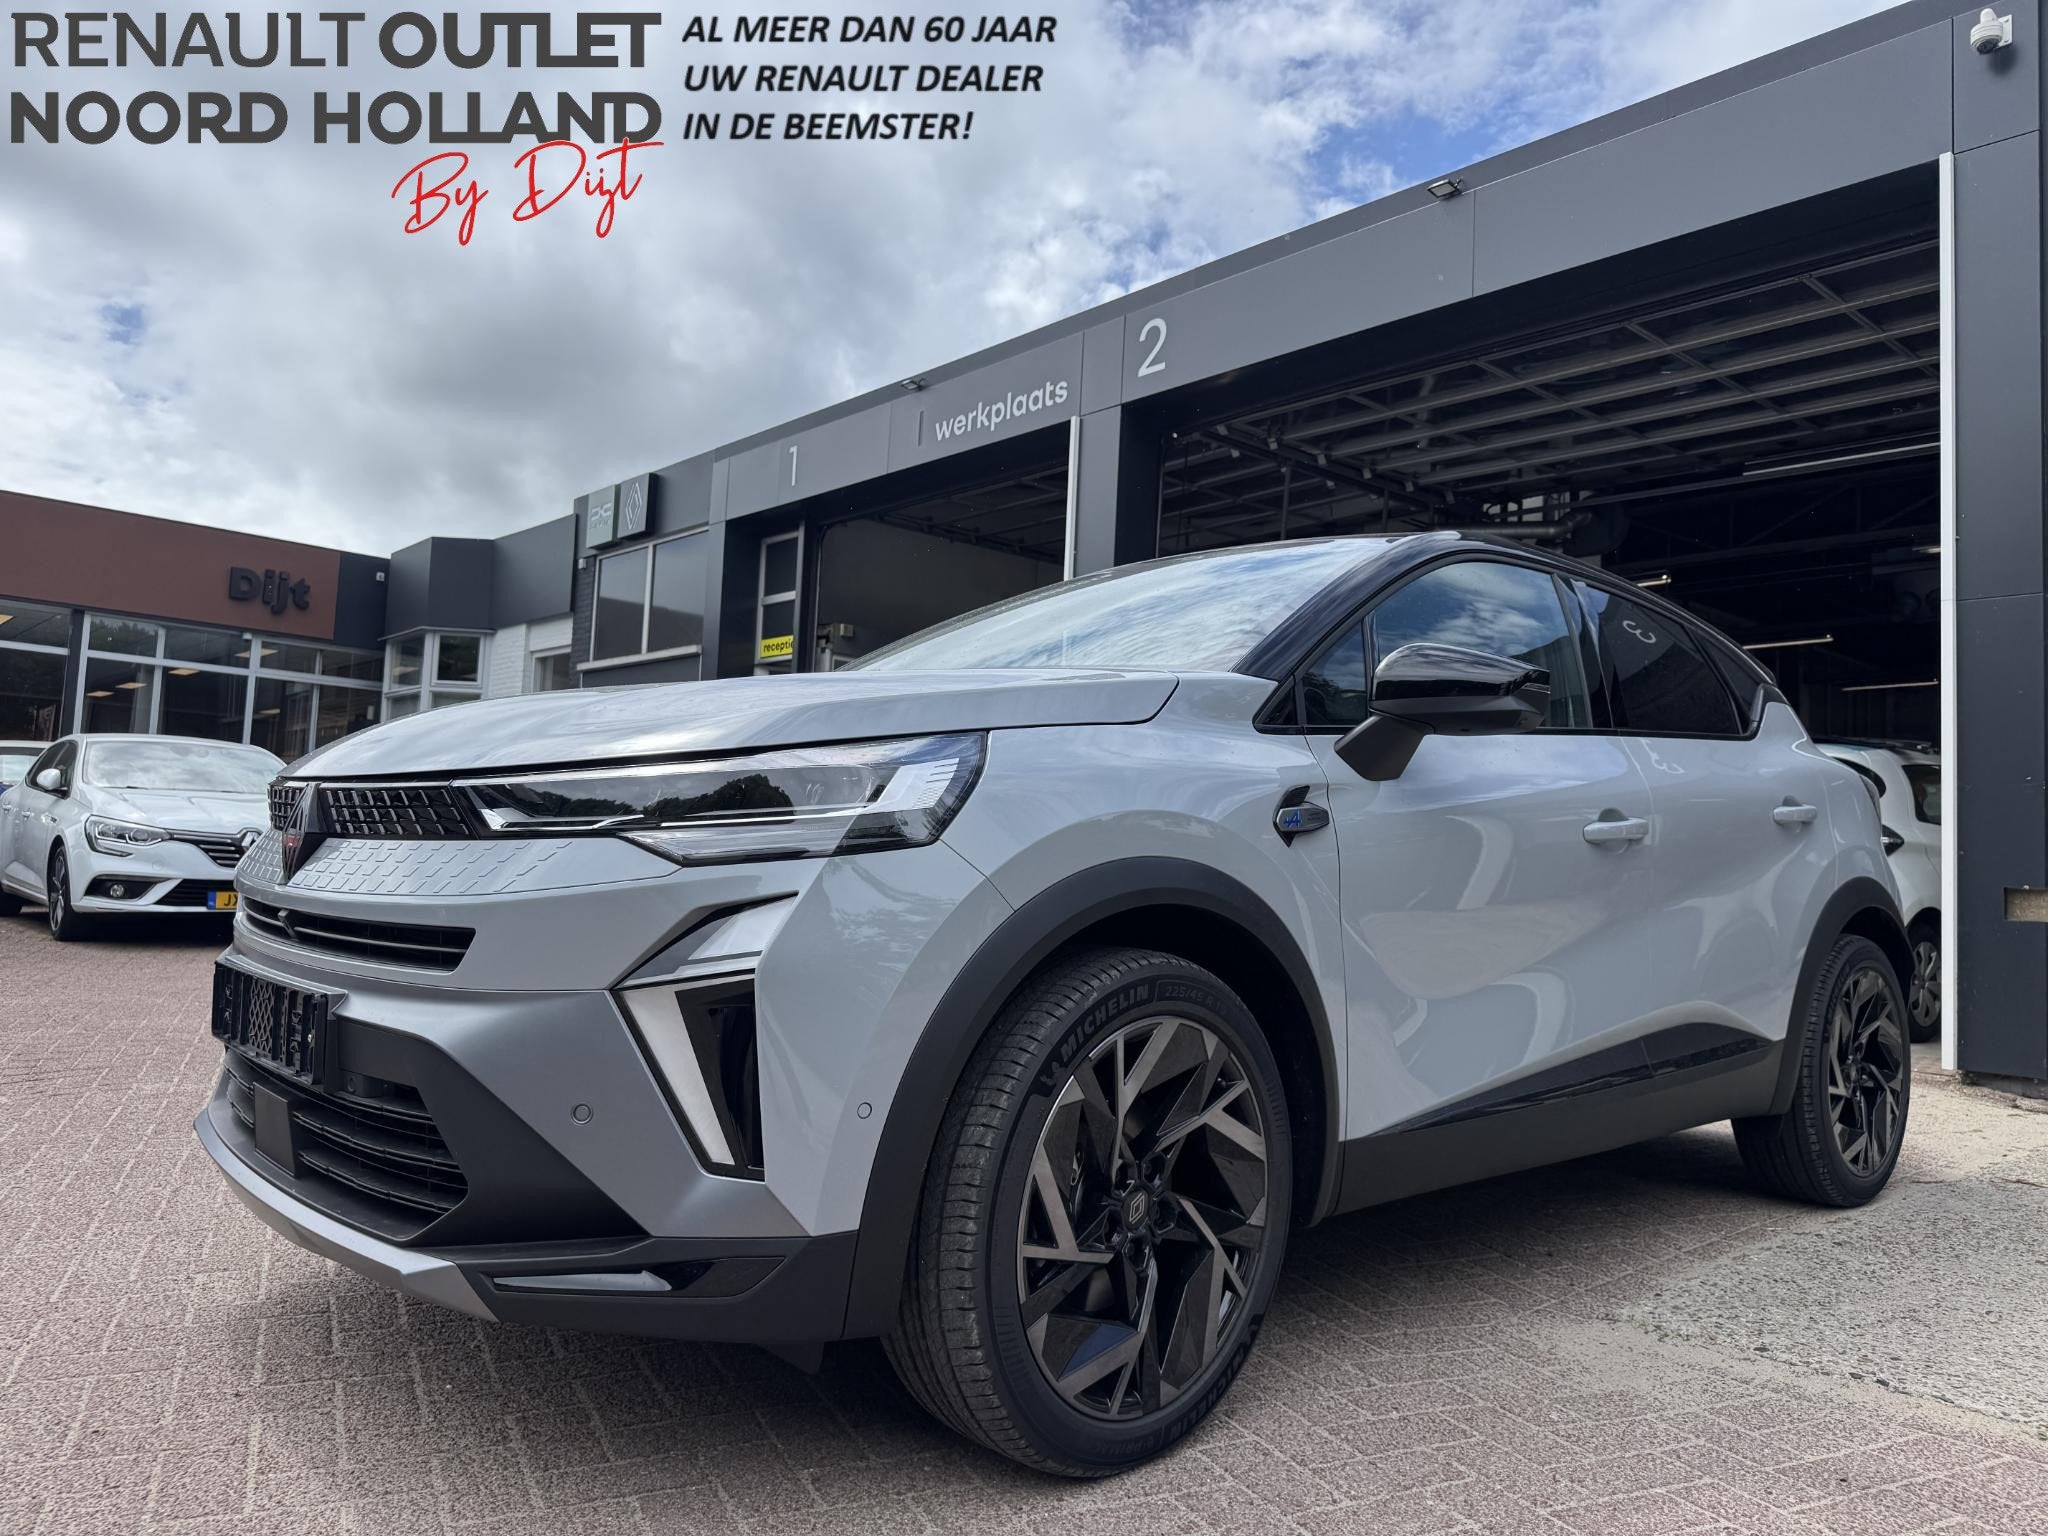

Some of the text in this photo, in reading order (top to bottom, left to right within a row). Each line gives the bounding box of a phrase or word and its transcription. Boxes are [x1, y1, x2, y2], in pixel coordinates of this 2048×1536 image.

[1137, 317, 1167, 378] 2
[935, 380, 1069, 442] werkplaats
[789, 445, 798, 487] 1
[229, 566, 311, 615] Dijt
[1060, 983, 1150, 1062] MICHELIN
